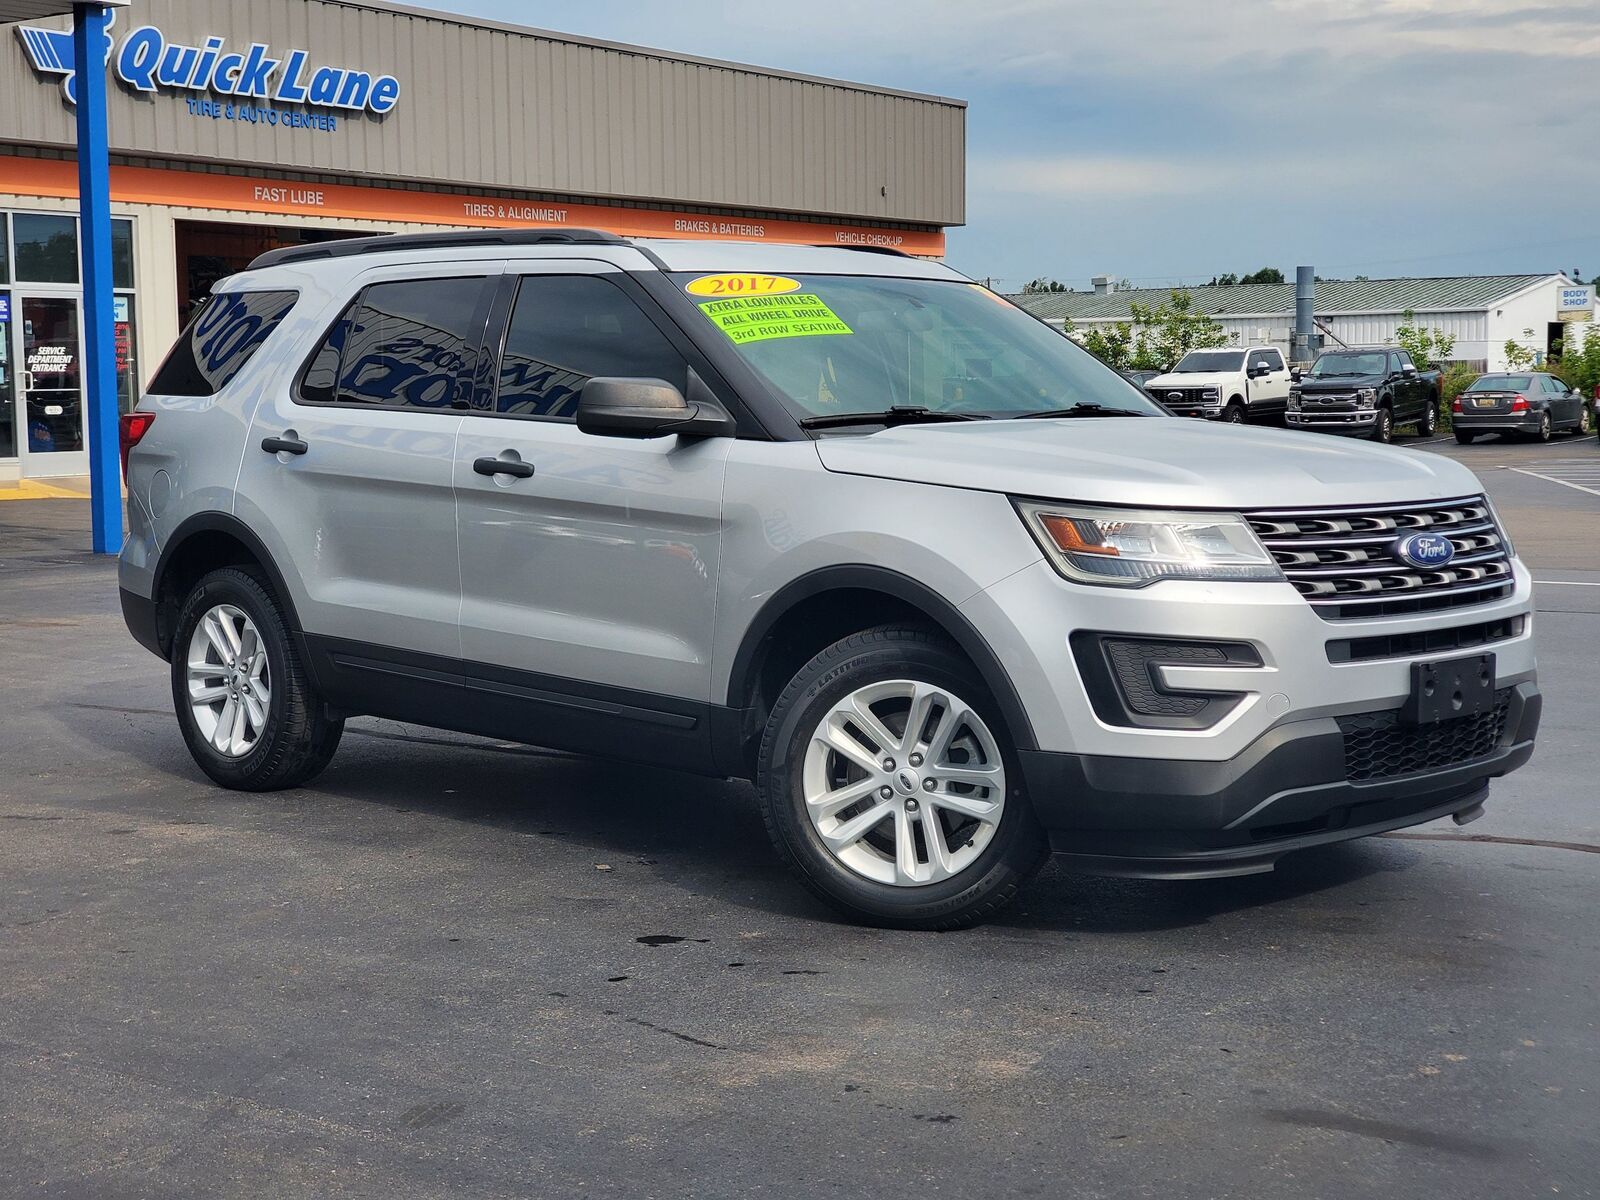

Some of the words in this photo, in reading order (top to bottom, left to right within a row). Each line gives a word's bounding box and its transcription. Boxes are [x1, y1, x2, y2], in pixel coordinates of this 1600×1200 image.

[118, 26, 281, 98] Quick
[275, 49, 400, 114] Lane
[187, 98, 220, 119] TIRE
[225, 103, 235, 120] &
[238, 106, 279, 126] AUTO
[281, 112, 336, 132] CENTER
[254, 187, 287, 202] FAST
[290, 190, 324, 206] LUBE
[464, 203, 495, 218] TIRES
[498, 206, 505, 218] &
[508, 207, 567, 223] ALIGNMENT
[674, 220, 710, 233] BRAKES
[712, 222, 718, 233] &
[720, 223, 765, 237] BATTERIES
[835, 232, 866, 244] VEHICLE
[867, 234, 903, 246] CHECK-UP
[710, 277, 777, 294] 2017
[705, 300, 744, 314] XTRA
[745, 297, 775, 308] LOW
[774, 295, 817, 307] MILES
[722, 314, 746, 327] ALL
[747, 310, 791, 322] WHEEL
[794, 308, 829, 318] DRIVE
[732, 328, 756, 340] 3rd
[760, 325, 789, 335] ROW
[793, 322, 846, 332] SEATING
[28, 355, 73, 364] DEPARTMENT
[38, 346, 66, 355] SERVICE
[31, 364, 67, 372] ENTRANCE
[1418, 538, 1447, 558] Ford
